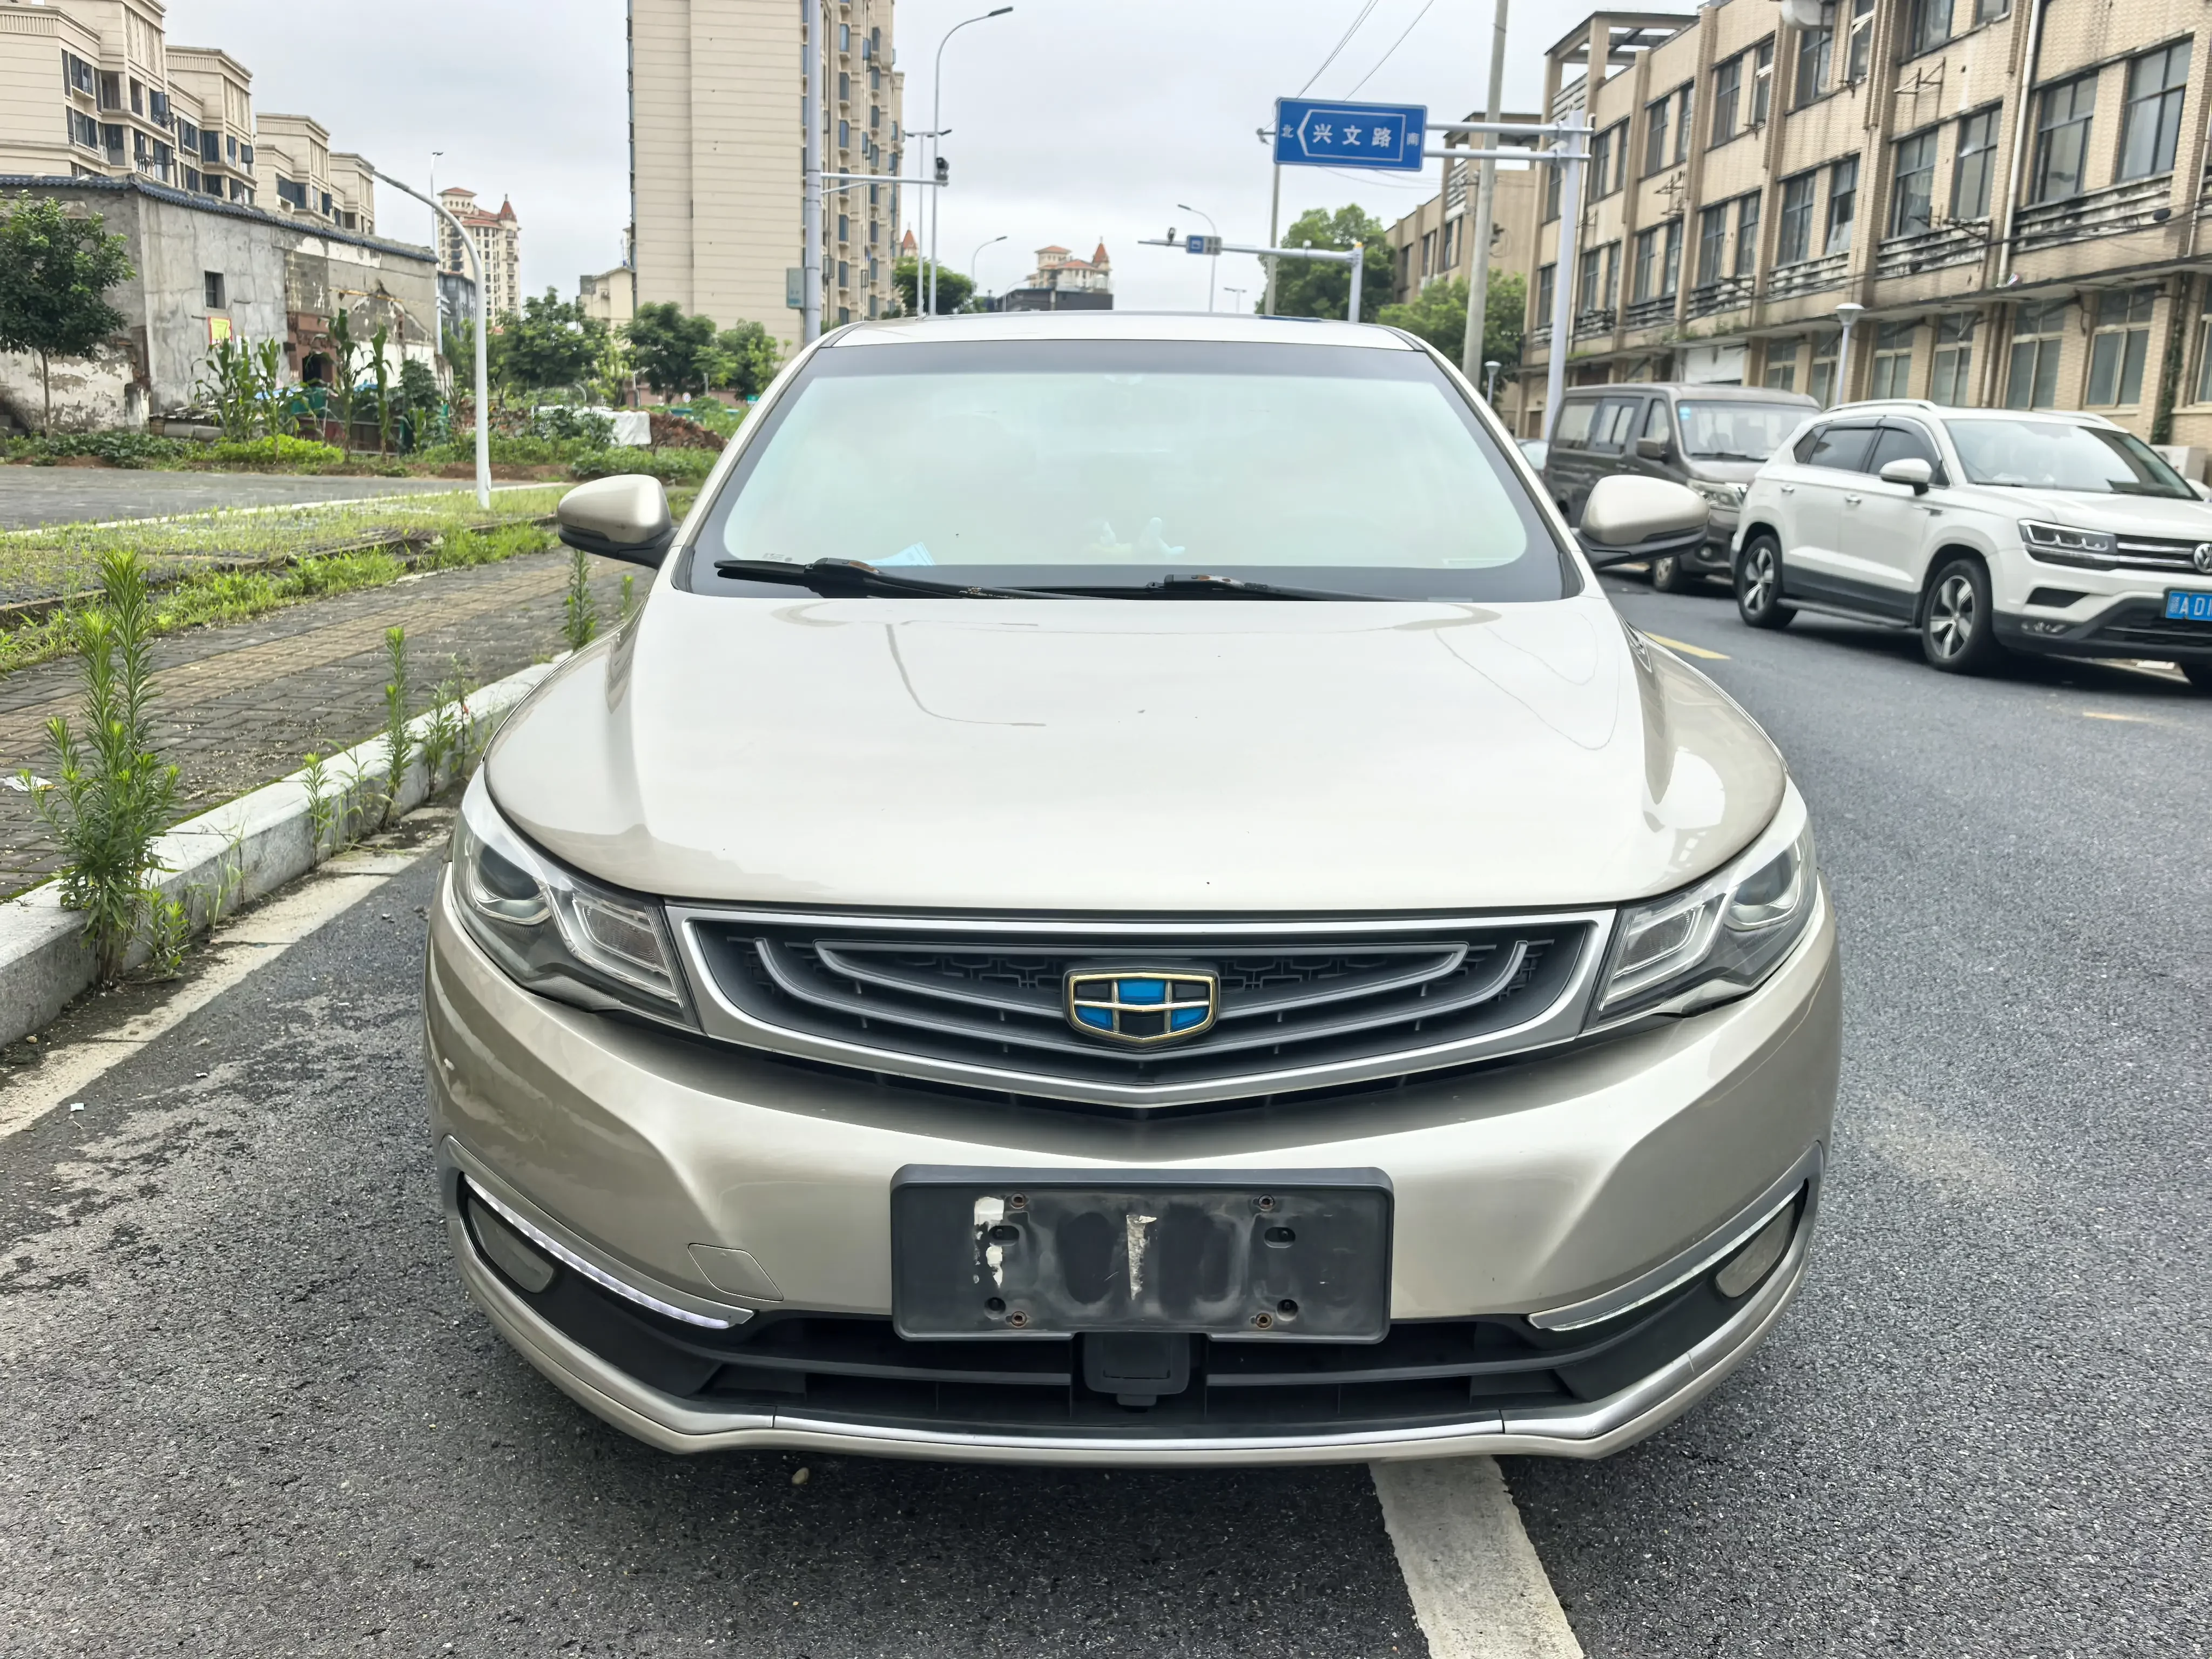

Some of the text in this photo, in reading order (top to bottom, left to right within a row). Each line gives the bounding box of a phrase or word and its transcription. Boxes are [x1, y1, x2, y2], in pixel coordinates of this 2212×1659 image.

[1280, 123, 1420, 148] 北 兴文路 南
